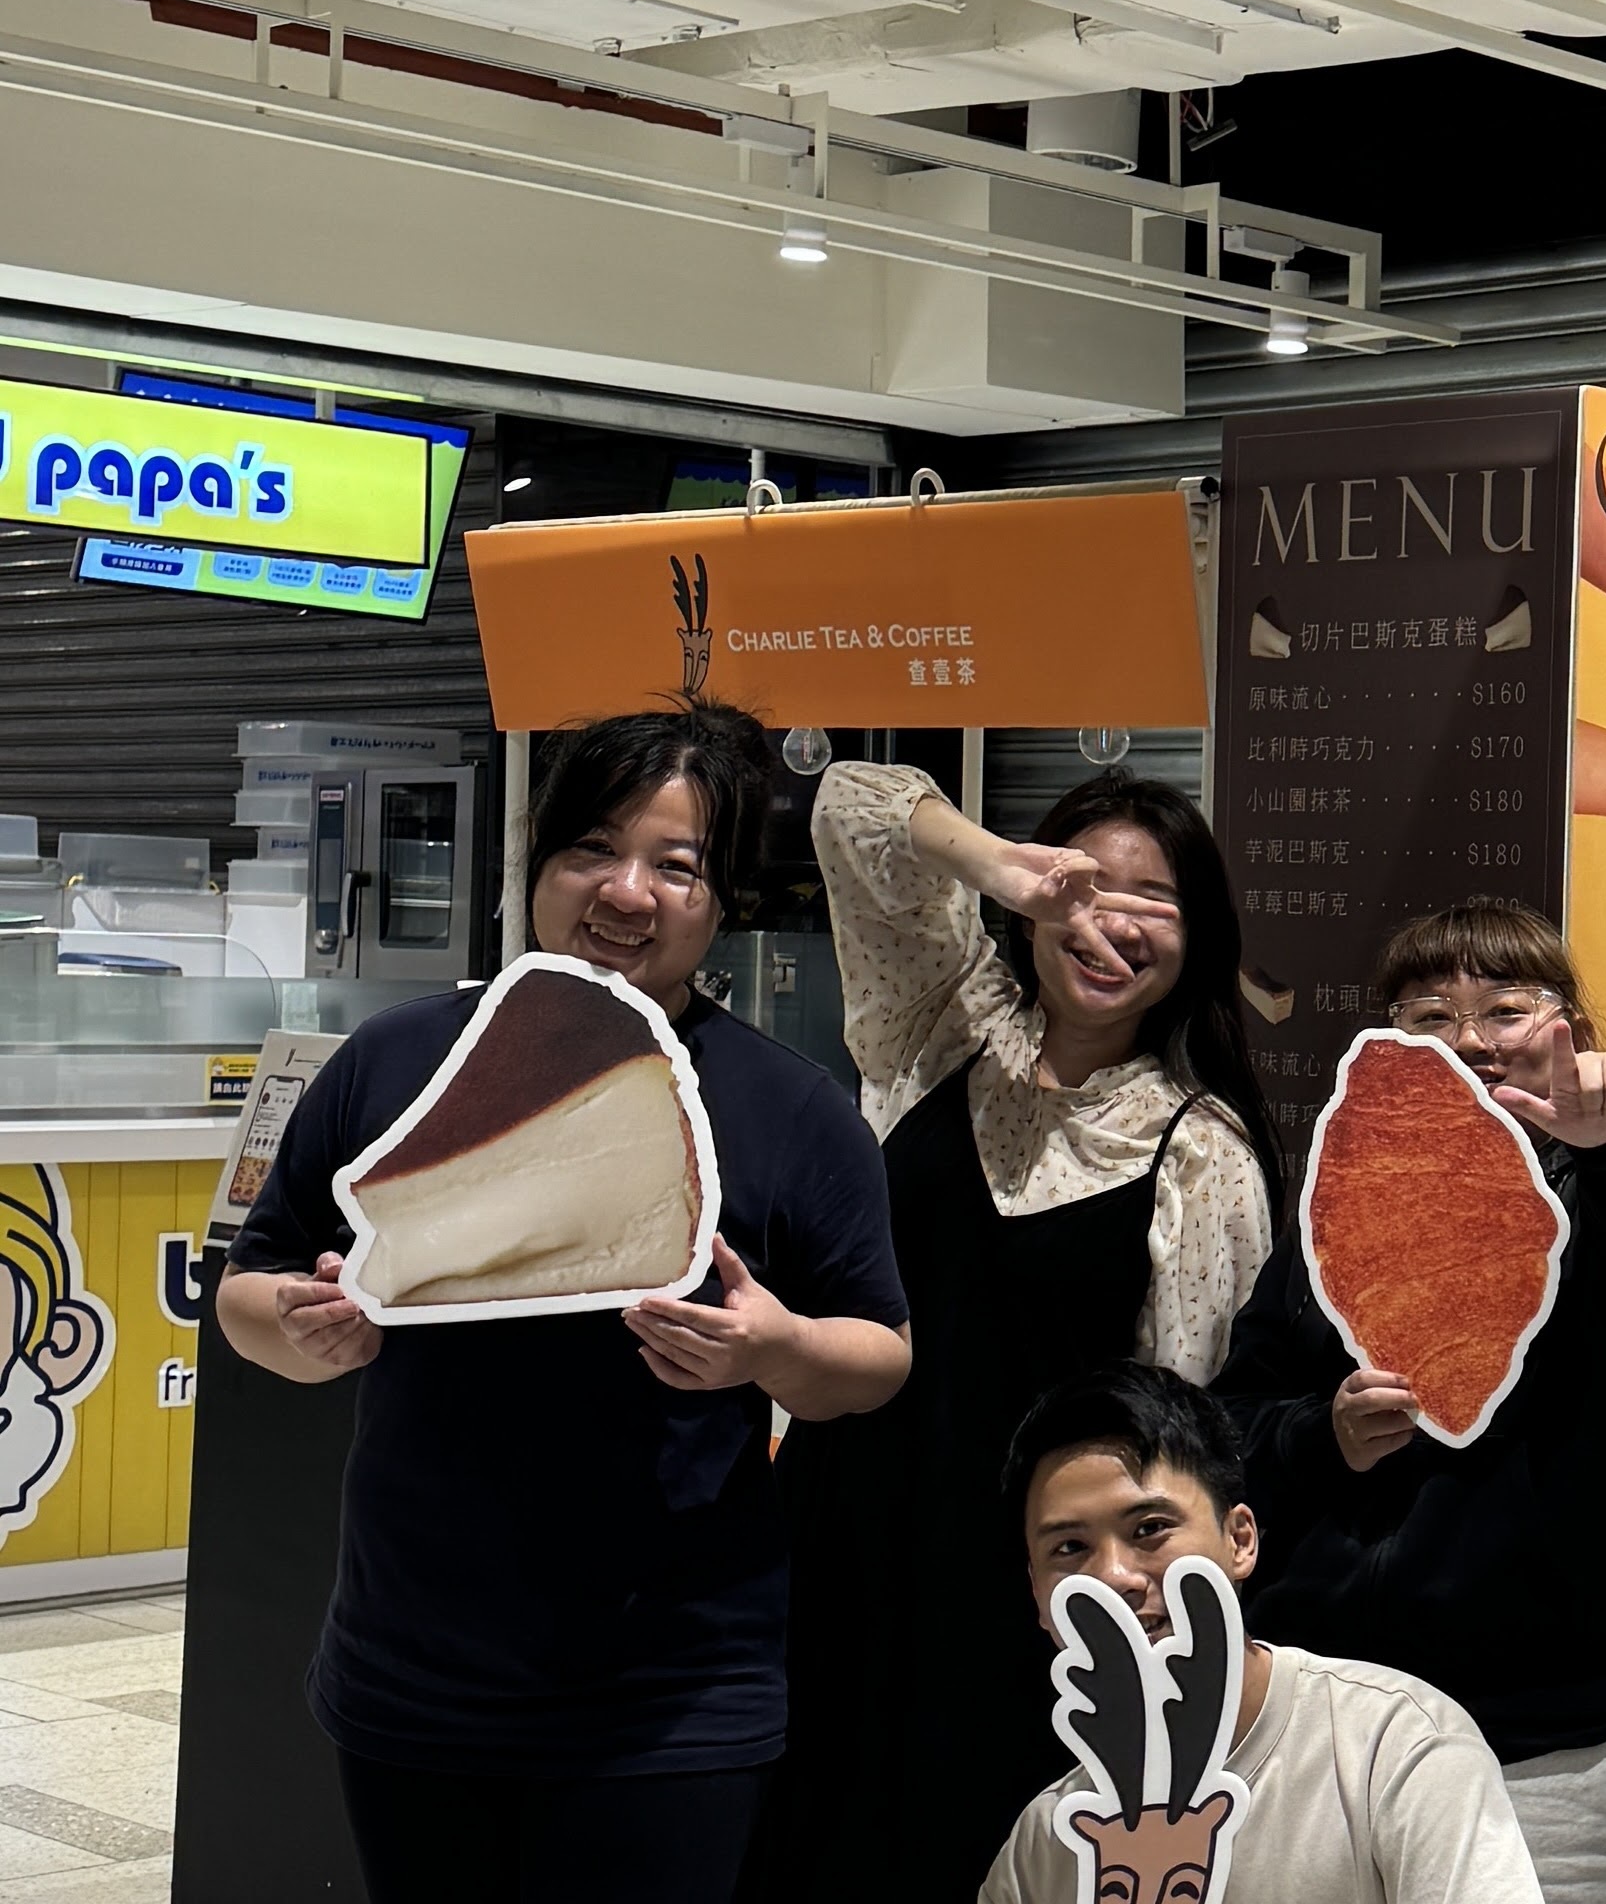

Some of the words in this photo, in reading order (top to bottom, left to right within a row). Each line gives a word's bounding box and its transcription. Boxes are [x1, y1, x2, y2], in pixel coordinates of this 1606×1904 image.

[35, 442, 286, 518] papa's
[1252, 467, 1537, 566] MENU
[867, 624, 884, 648] &
[1299, 616, 1478, 652] 切片巴斯克蛋糕
[908, 657, 976, 686] 查壹茶
[1249, 685, 1332, 712] 原味流心
[1247, 736, 1375, 762] 比利時巧克力
[1246, 787, 1352, 814] 小山園抹茶
[1244, 839, 1351, 865] 芋泥巴斯克
[1244, 889, 1349, 917] 草莓巴斯克
